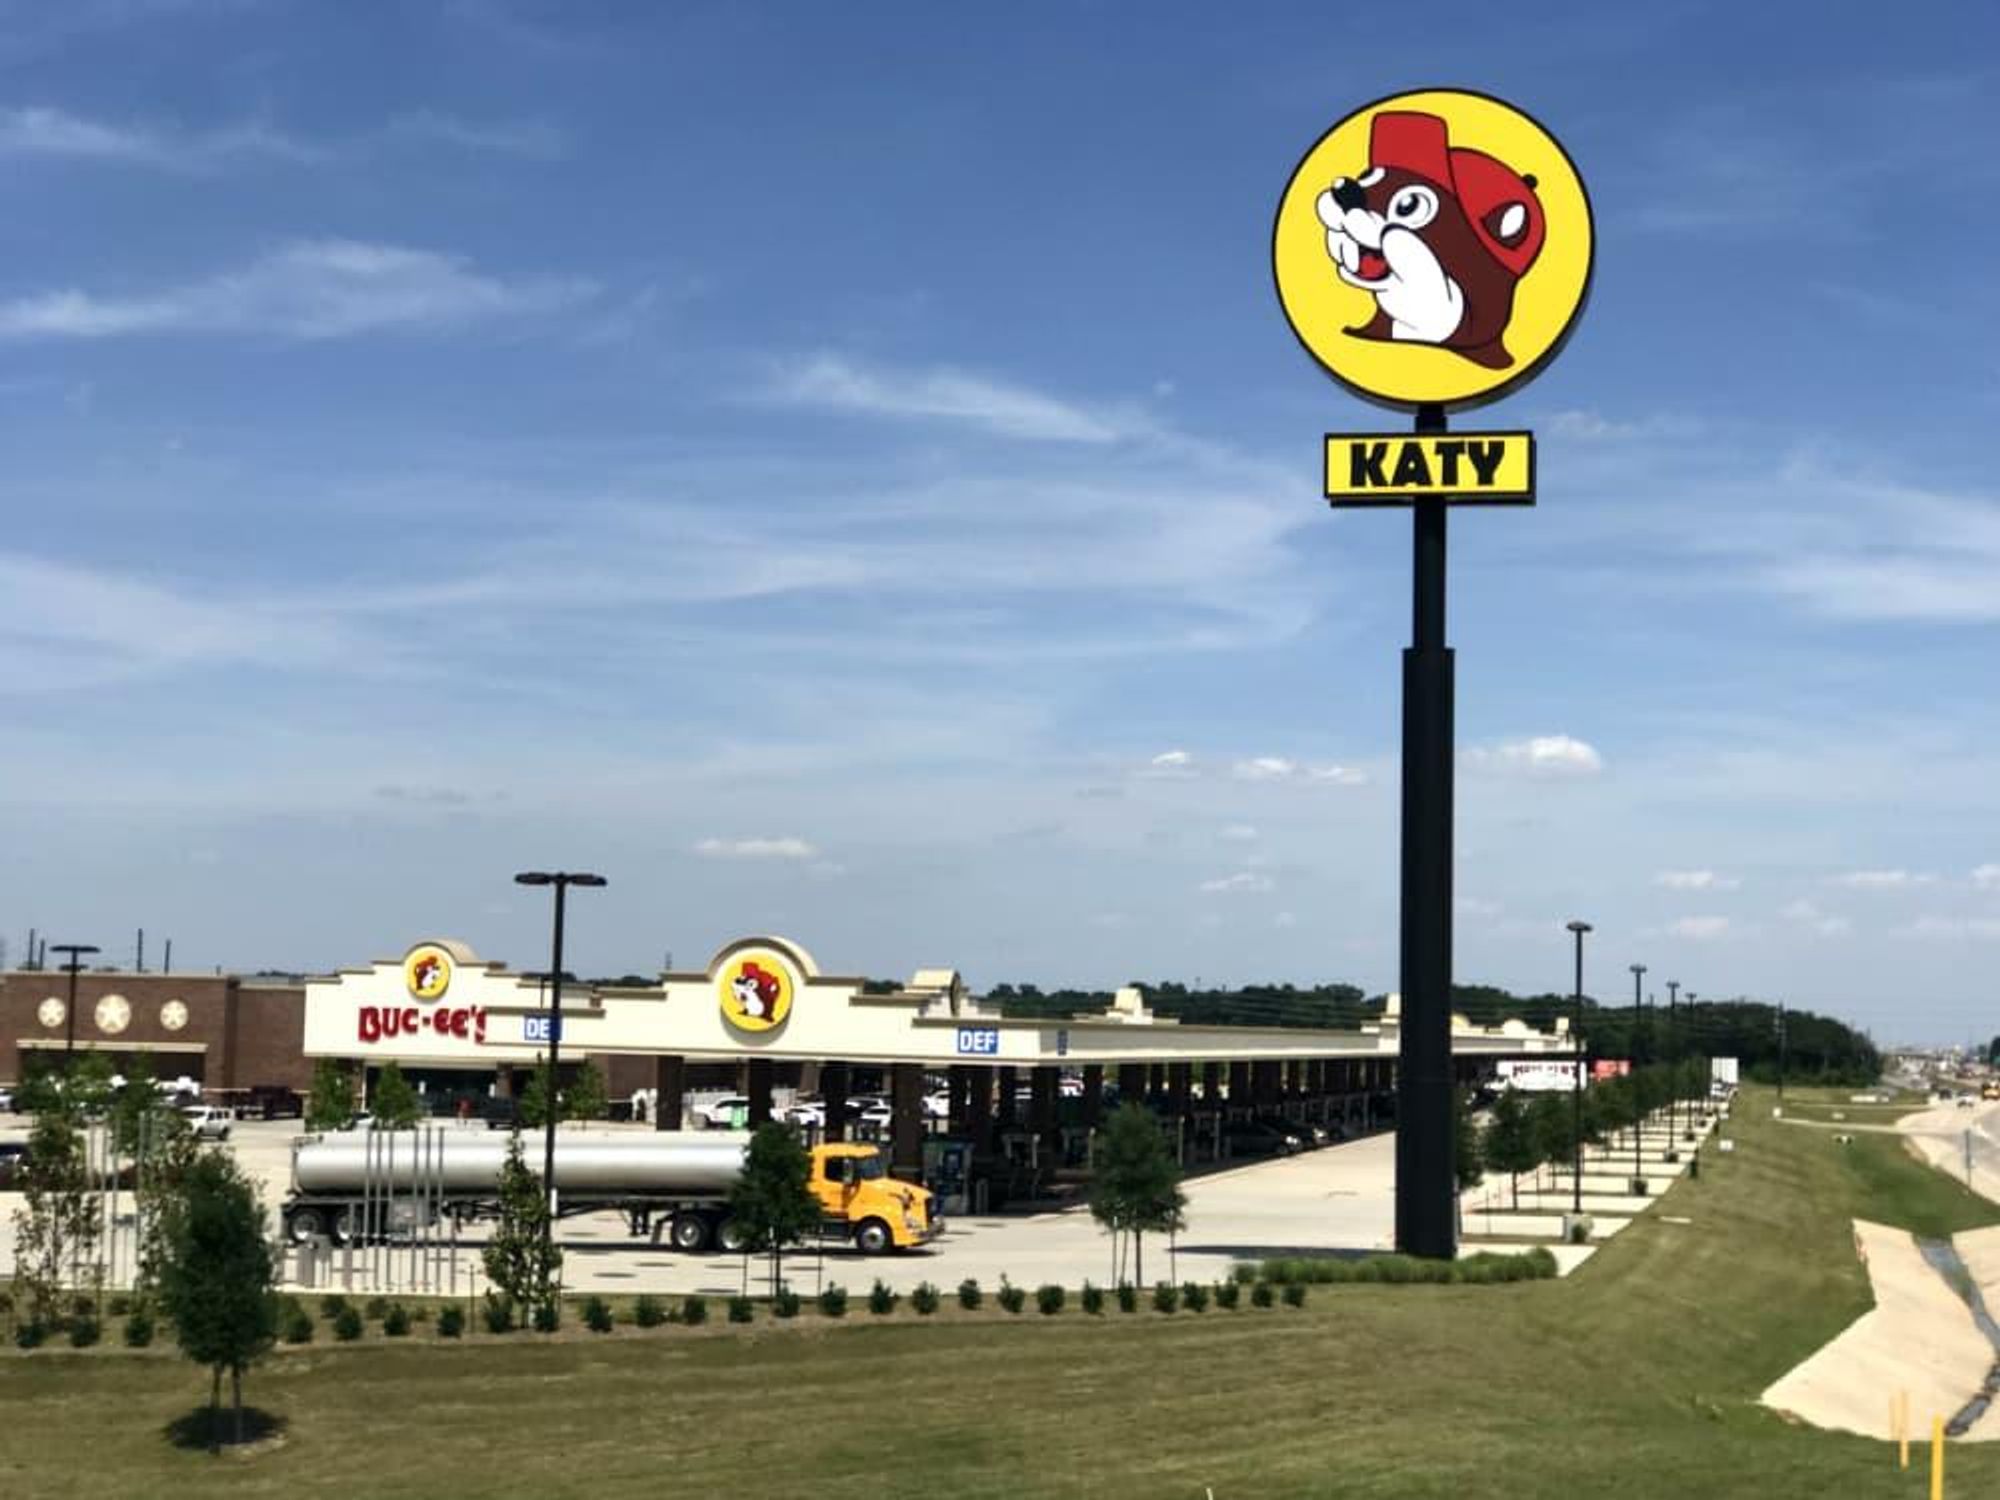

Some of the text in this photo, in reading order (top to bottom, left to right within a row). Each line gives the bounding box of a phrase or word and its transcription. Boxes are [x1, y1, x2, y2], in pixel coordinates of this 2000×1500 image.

[1350, 440, 1505, 488] KATY
[526, 1018, 551, 1038] DE
[960, 1030, 996, 1052] DEF
